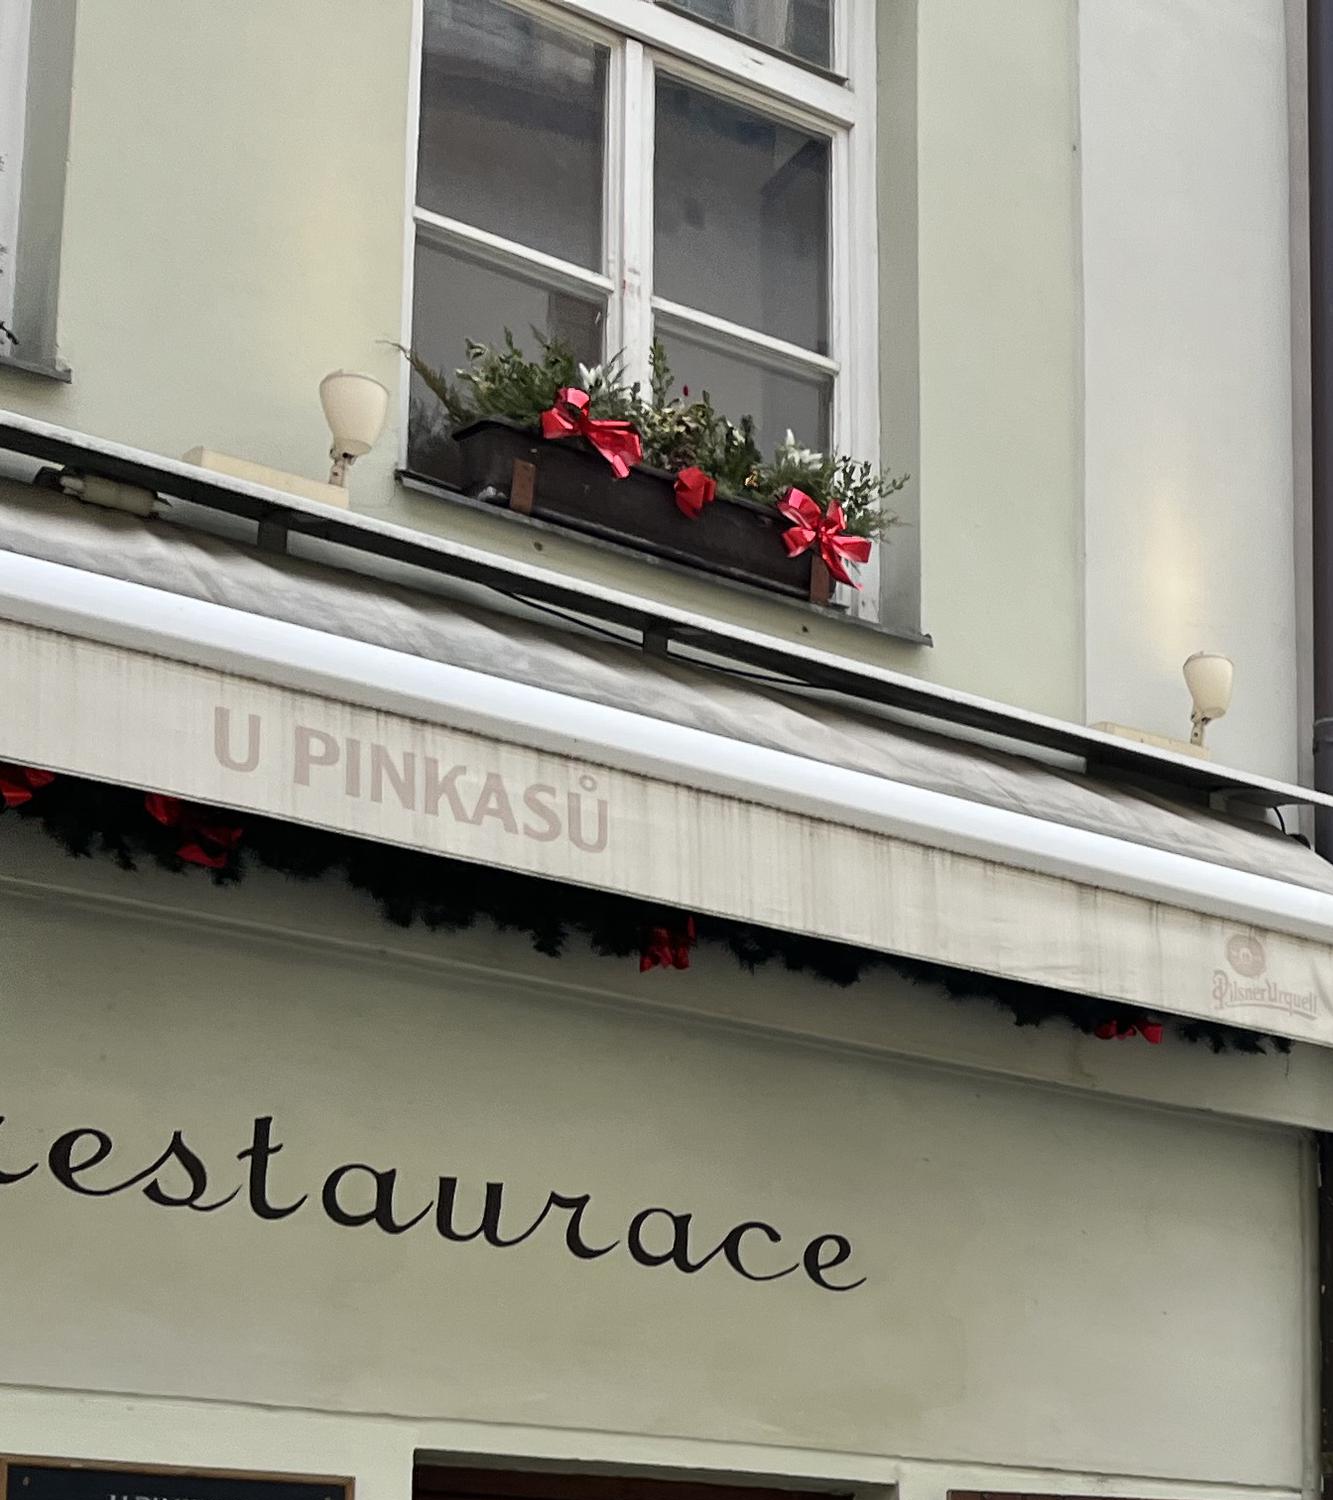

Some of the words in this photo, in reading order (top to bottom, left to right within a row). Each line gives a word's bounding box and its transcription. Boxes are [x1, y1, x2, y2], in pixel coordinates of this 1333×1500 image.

[214, 706, 262, 773] U
[293, 725, 608, 854] PINKASŮ
[1212, 969, 1267, 1011] Pilsner
[1264, 978, 1319, 1017] Urquell
[0, 1114, 867, 1292] estaurace
